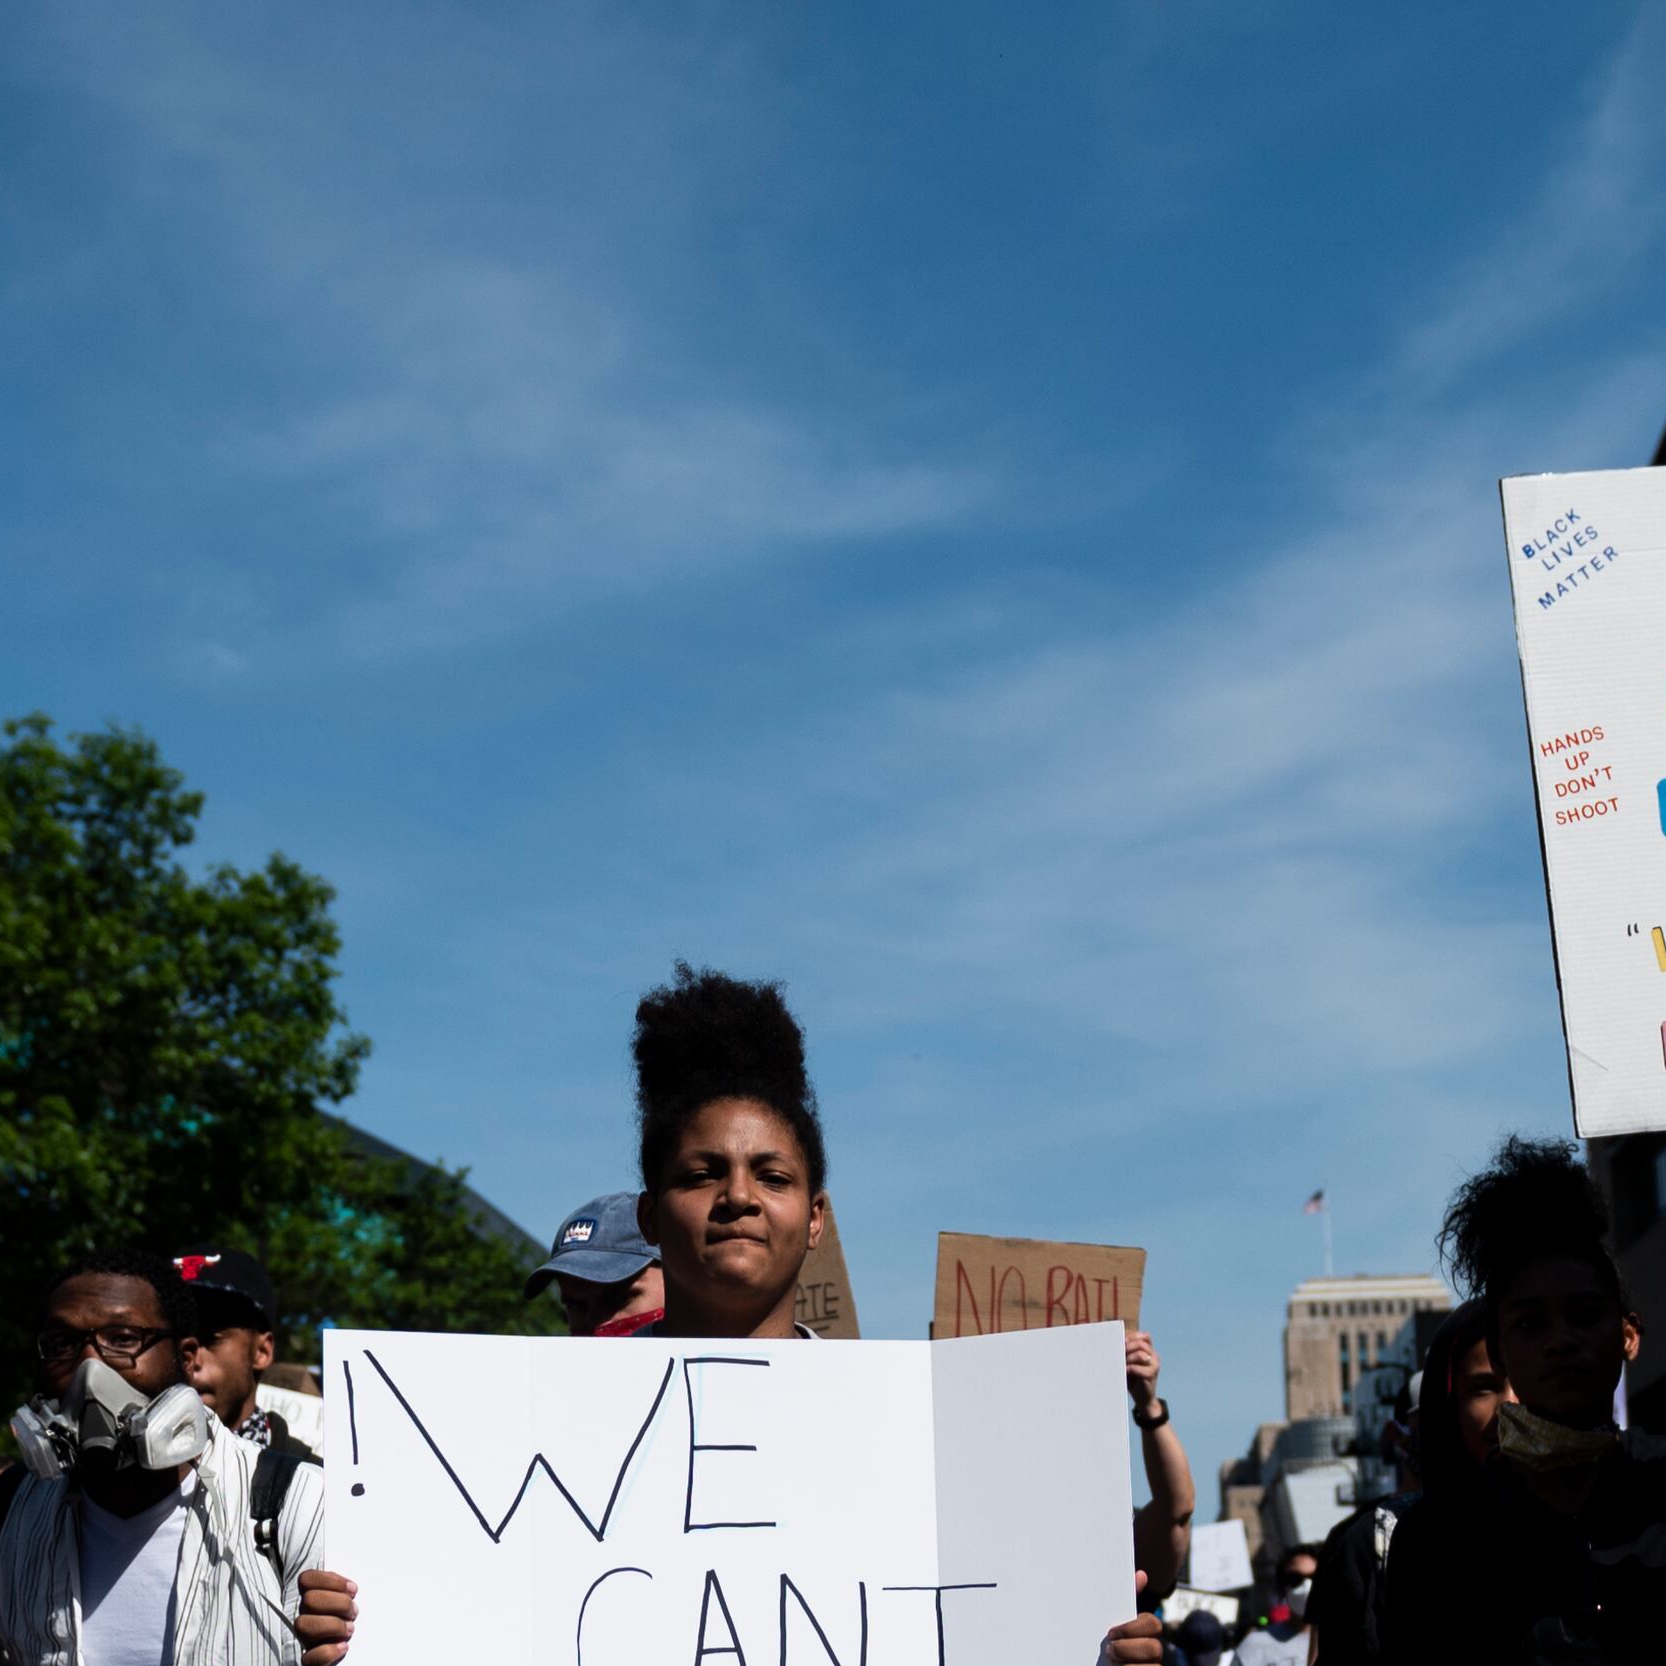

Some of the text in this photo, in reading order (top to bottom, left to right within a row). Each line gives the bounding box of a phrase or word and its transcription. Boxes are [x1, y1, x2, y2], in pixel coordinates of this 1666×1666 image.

[1522, 508, 1582, 560] BLACK
[1541, 524, 1600, 572] LIVES
[1537, 545, 1620, 610] MATTER
[1540, 725, 1606, 758] HANDS
[1564, 750, 1591, 772] UP
[1554, 766, 1614, 799] DON'T
[1554, 796, 1621, 826] SHOOT
[954, 1258, 1027, 1338] NO
